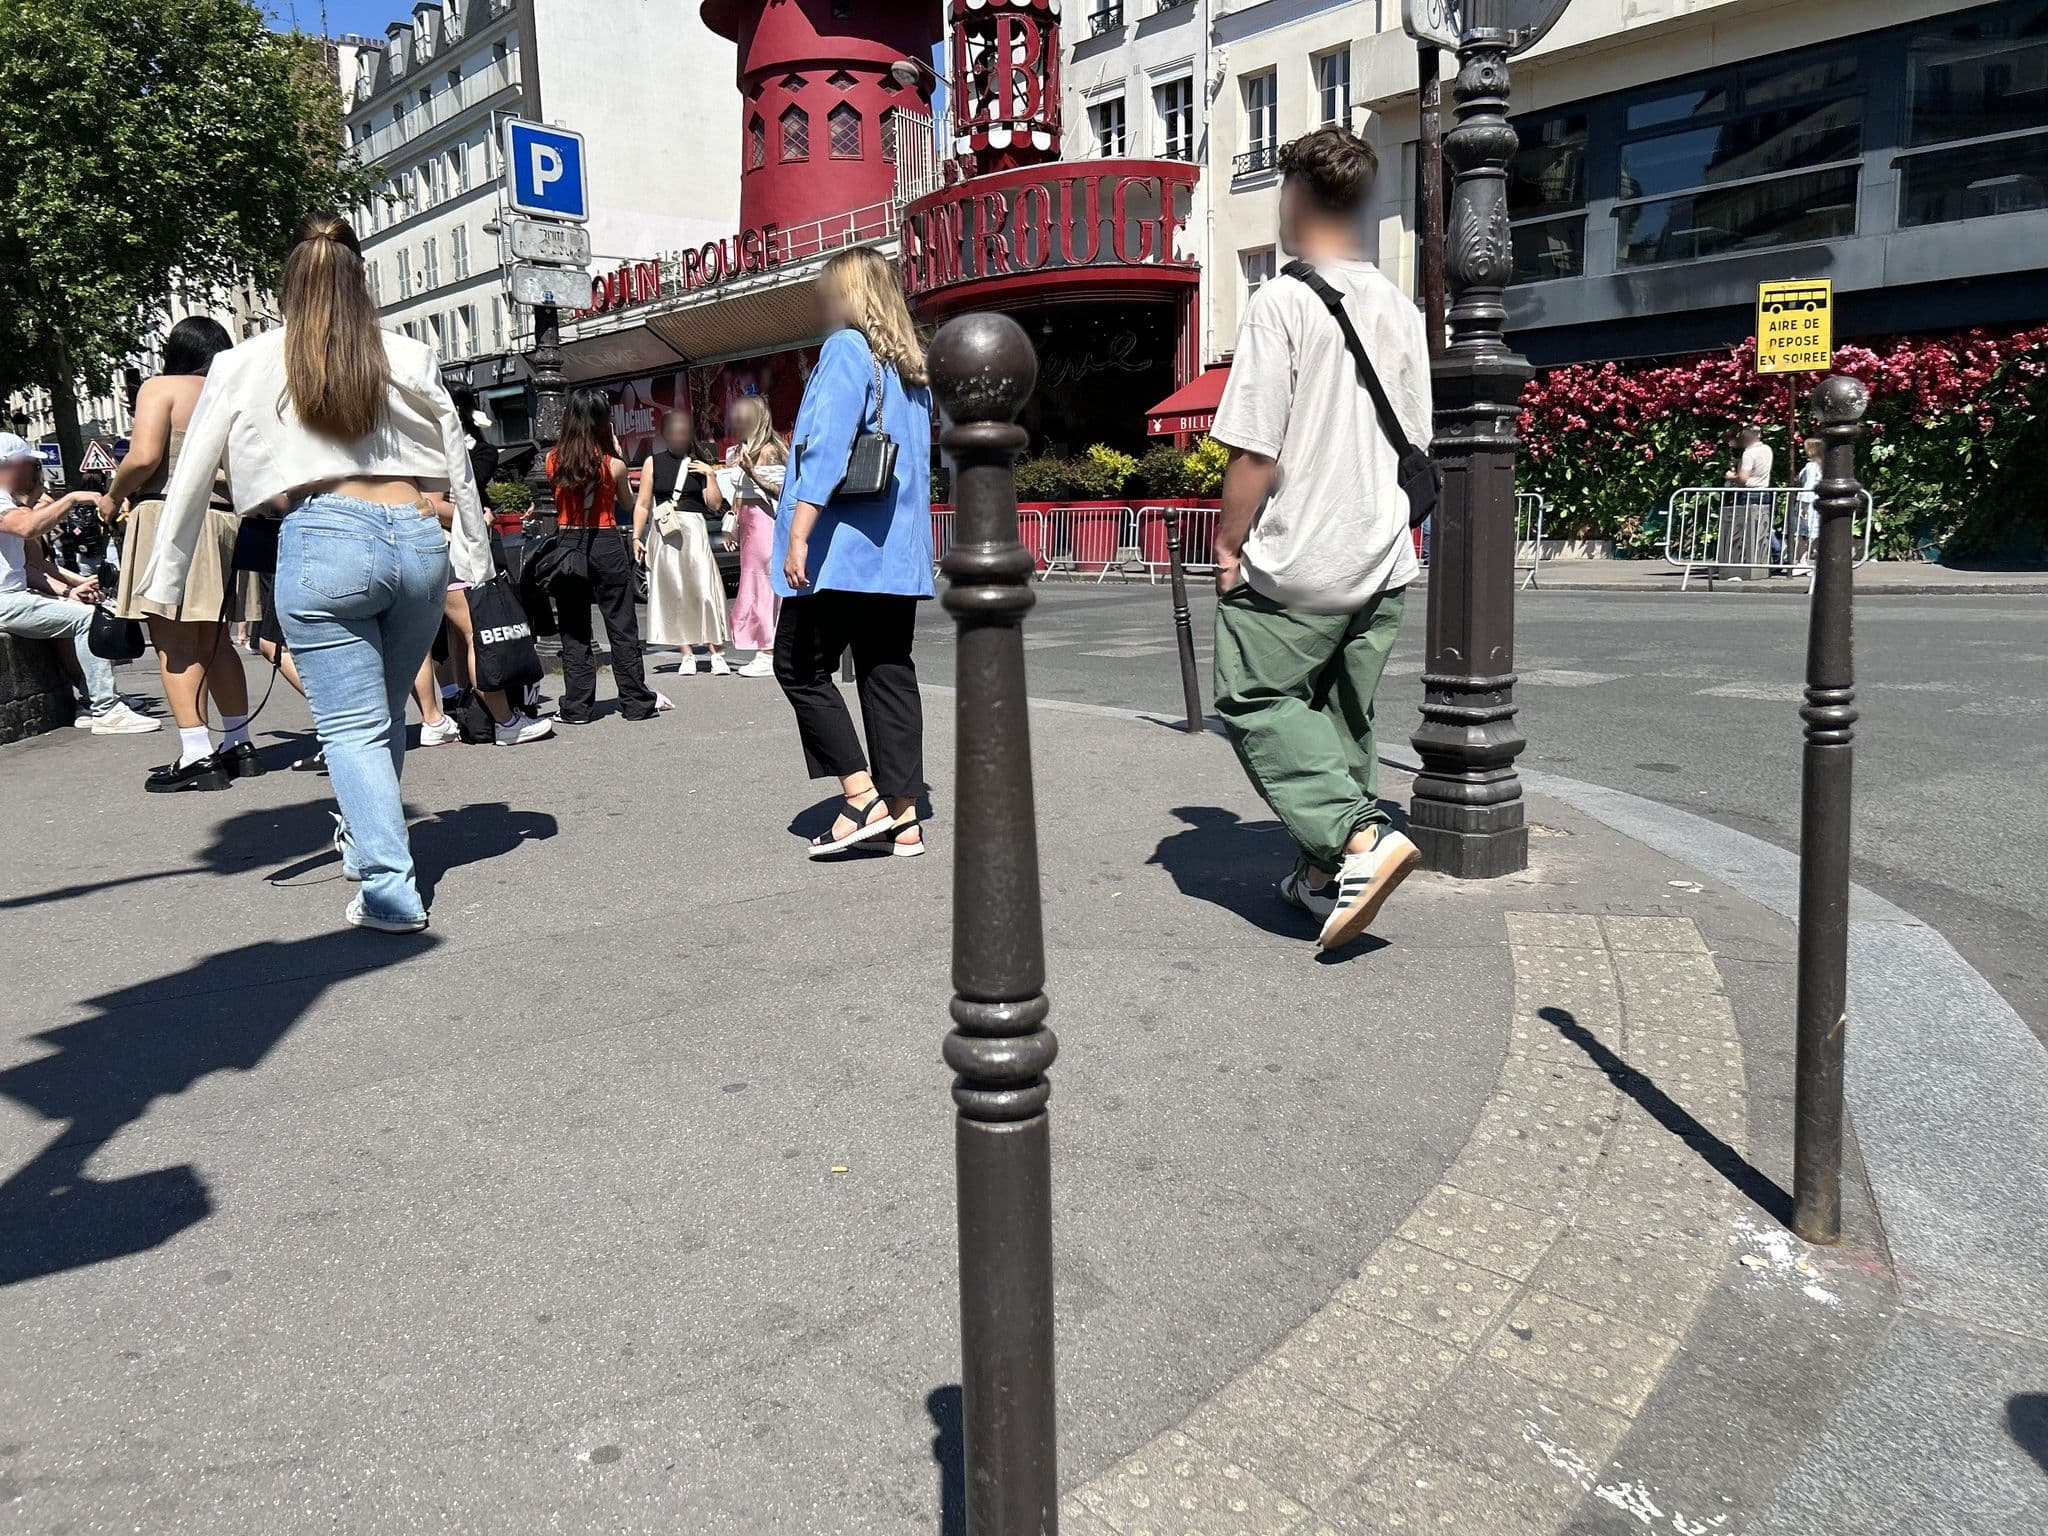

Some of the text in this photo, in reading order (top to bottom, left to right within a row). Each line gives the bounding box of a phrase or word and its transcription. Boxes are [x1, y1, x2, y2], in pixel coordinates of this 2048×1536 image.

[530, 142, 564, 196] P
[972, 176, 1197, 276] ROUGE
[575, 222, 779, 317] OULIN ROUGE
[1769, 318, 1820, 331] AIRE DE
[1179, 414, 1215, 430] BILLE
